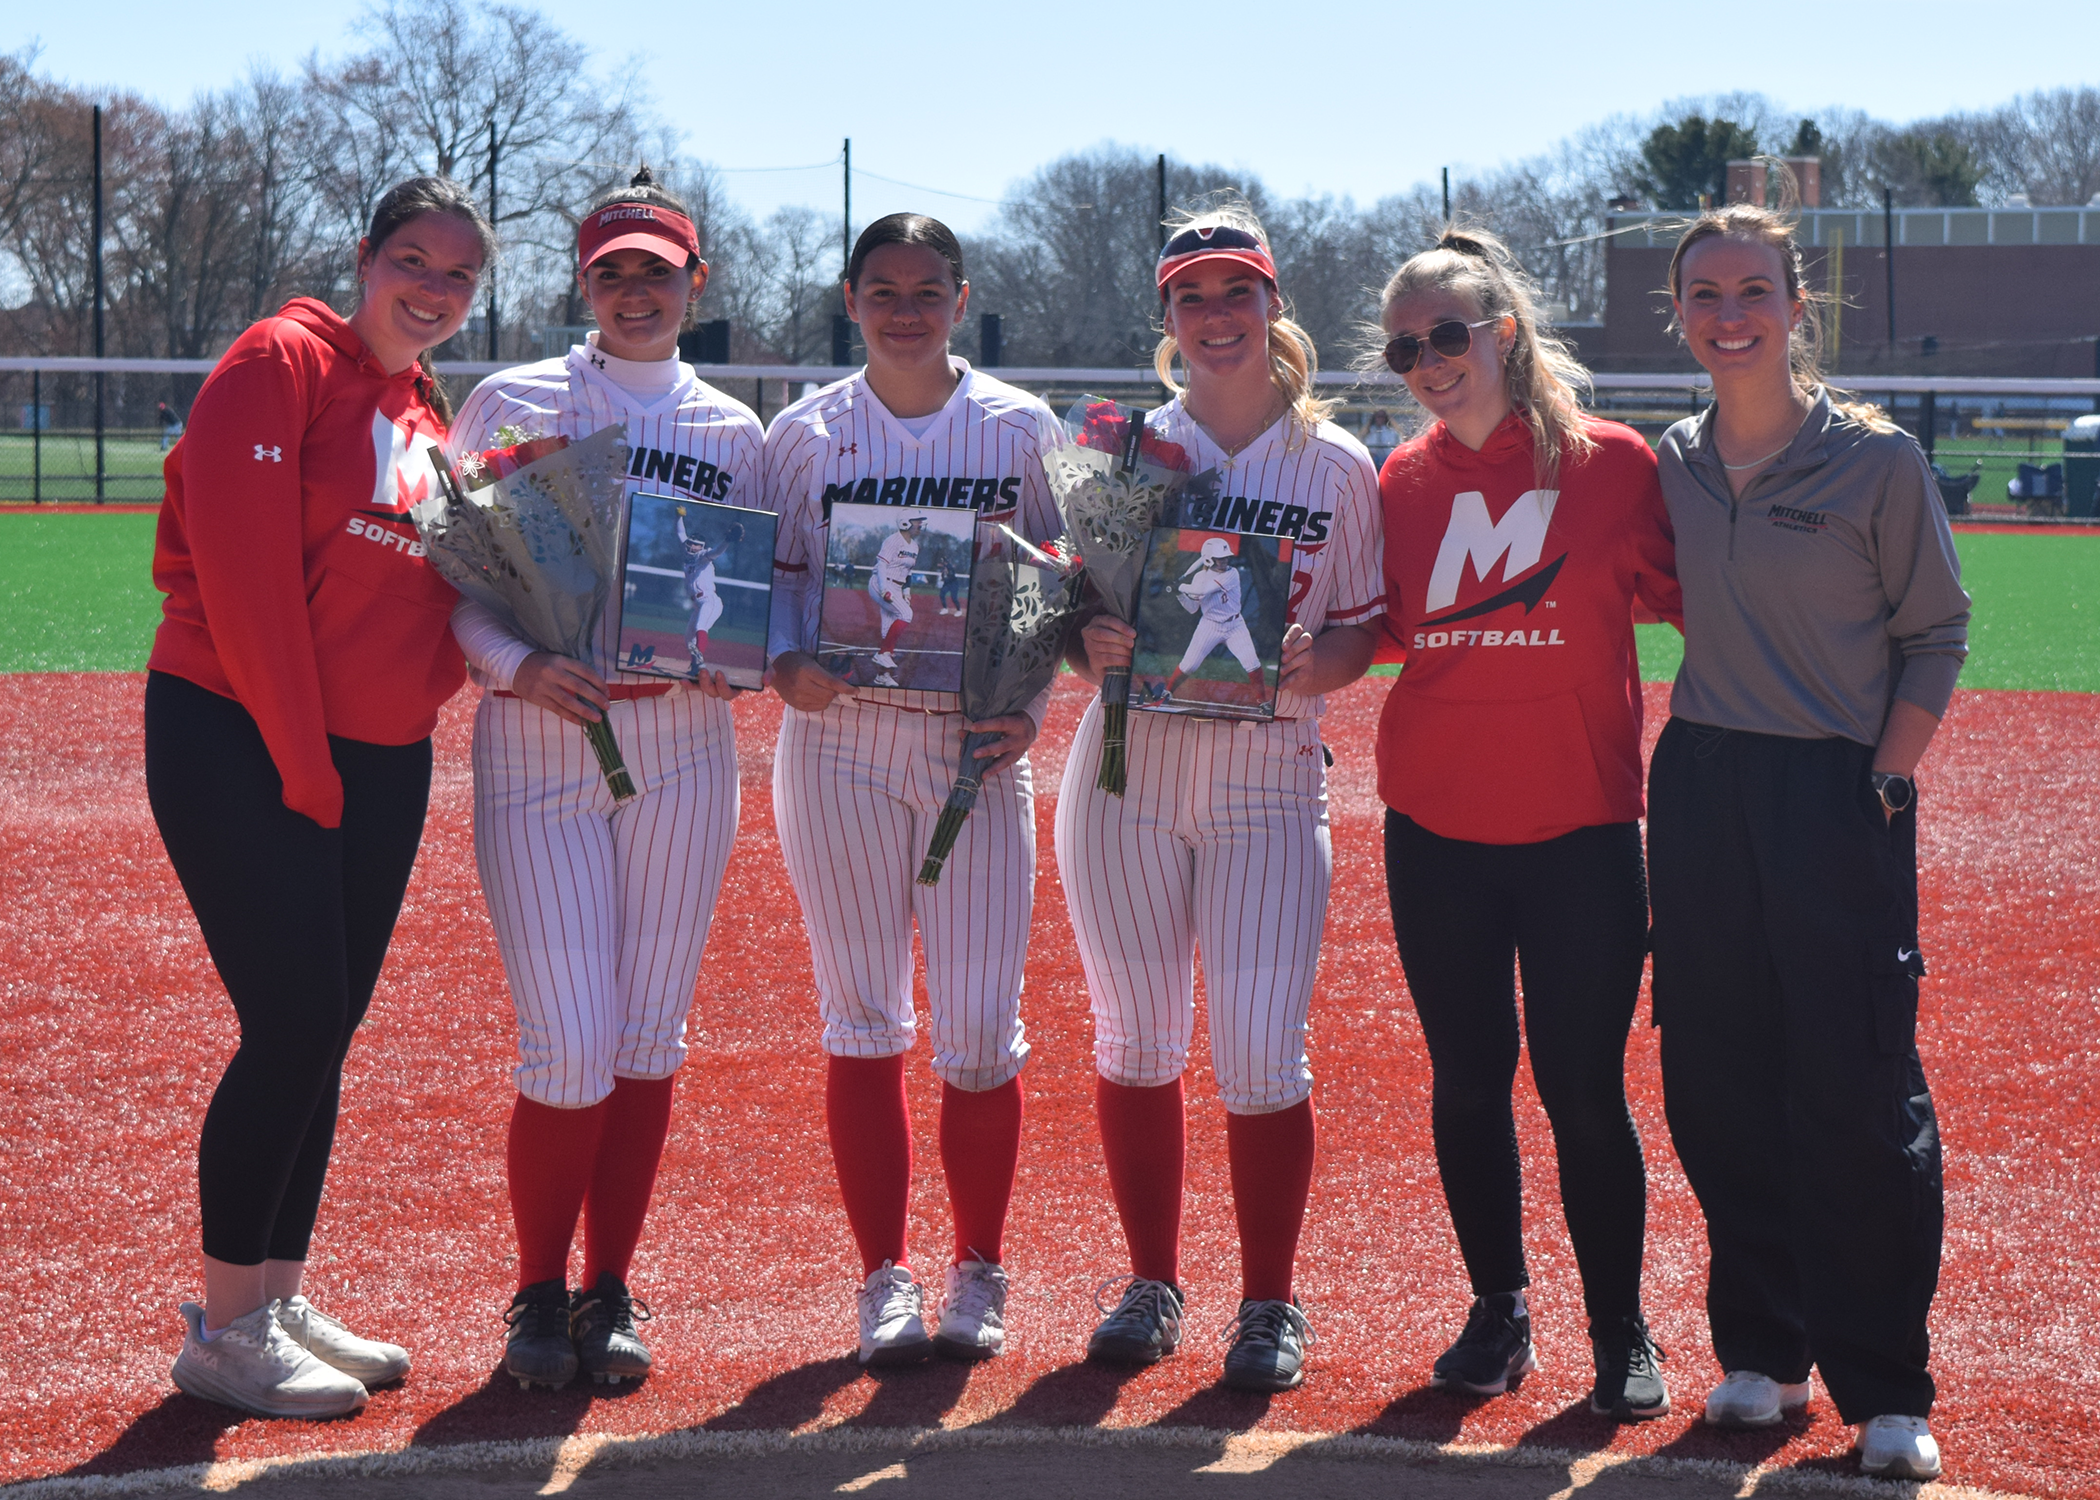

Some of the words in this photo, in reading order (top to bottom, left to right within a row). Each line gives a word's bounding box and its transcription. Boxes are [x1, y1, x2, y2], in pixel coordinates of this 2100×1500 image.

[599, 208, 656, 227] MITCHELL
[821, 476, 1022, 522] MARINERS
[1767, 504, 1827, 525] MITCHELL
[1772, 521, 1818, 534] ATHLETICS
[1425, 488, 1561, 614] M
[1413, 629, 1566, 650] SOFTBALL
